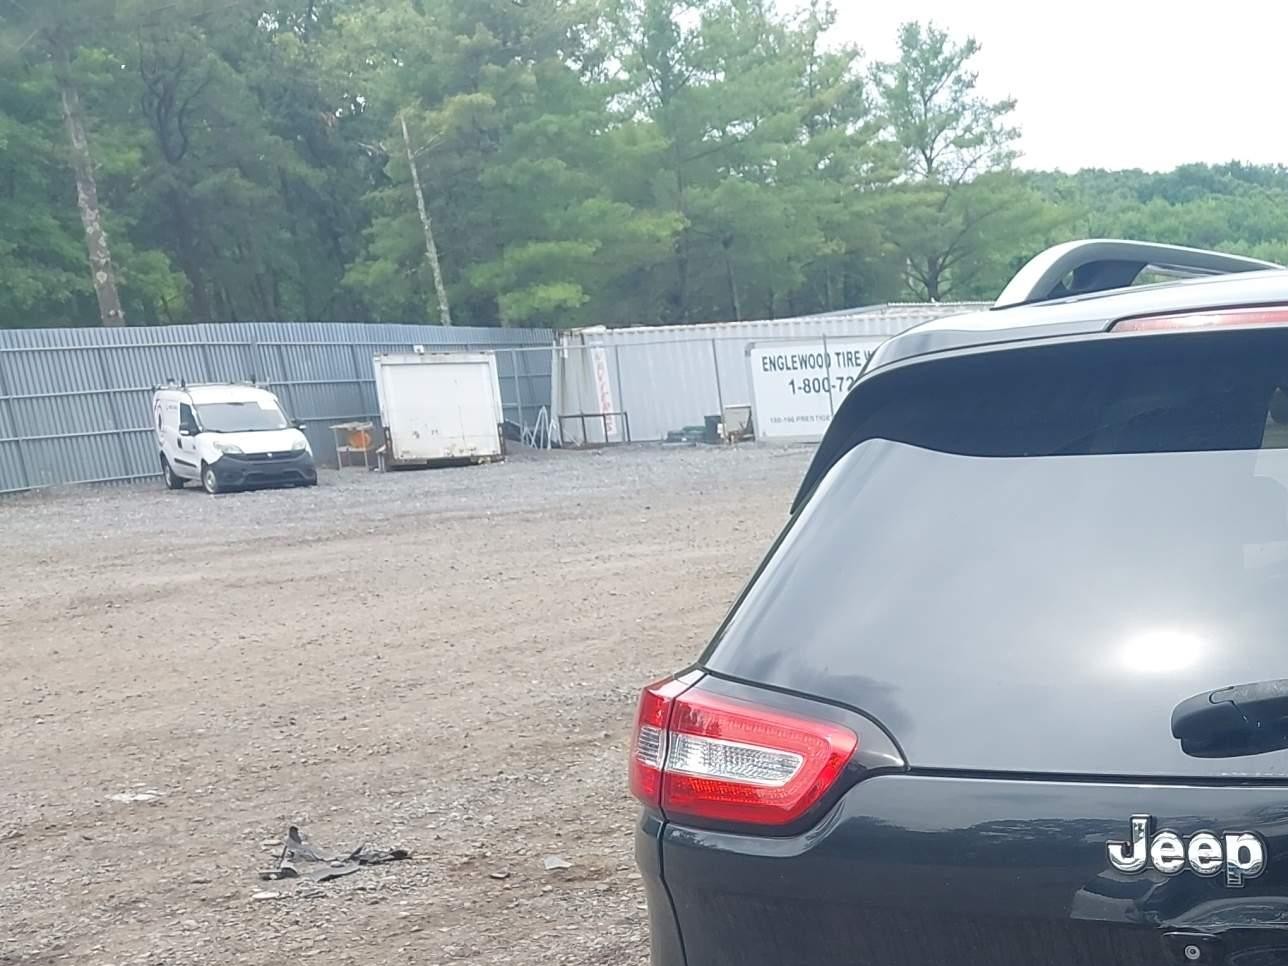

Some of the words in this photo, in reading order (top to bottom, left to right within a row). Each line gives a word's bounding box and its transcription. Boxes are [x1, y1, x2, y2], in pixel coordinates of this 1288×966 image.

[762, 353, 831, 372] ENGLEWOOD
[834, 350, 861, 368] TIRE
[1106, 814, 1267, 888] Jeep
